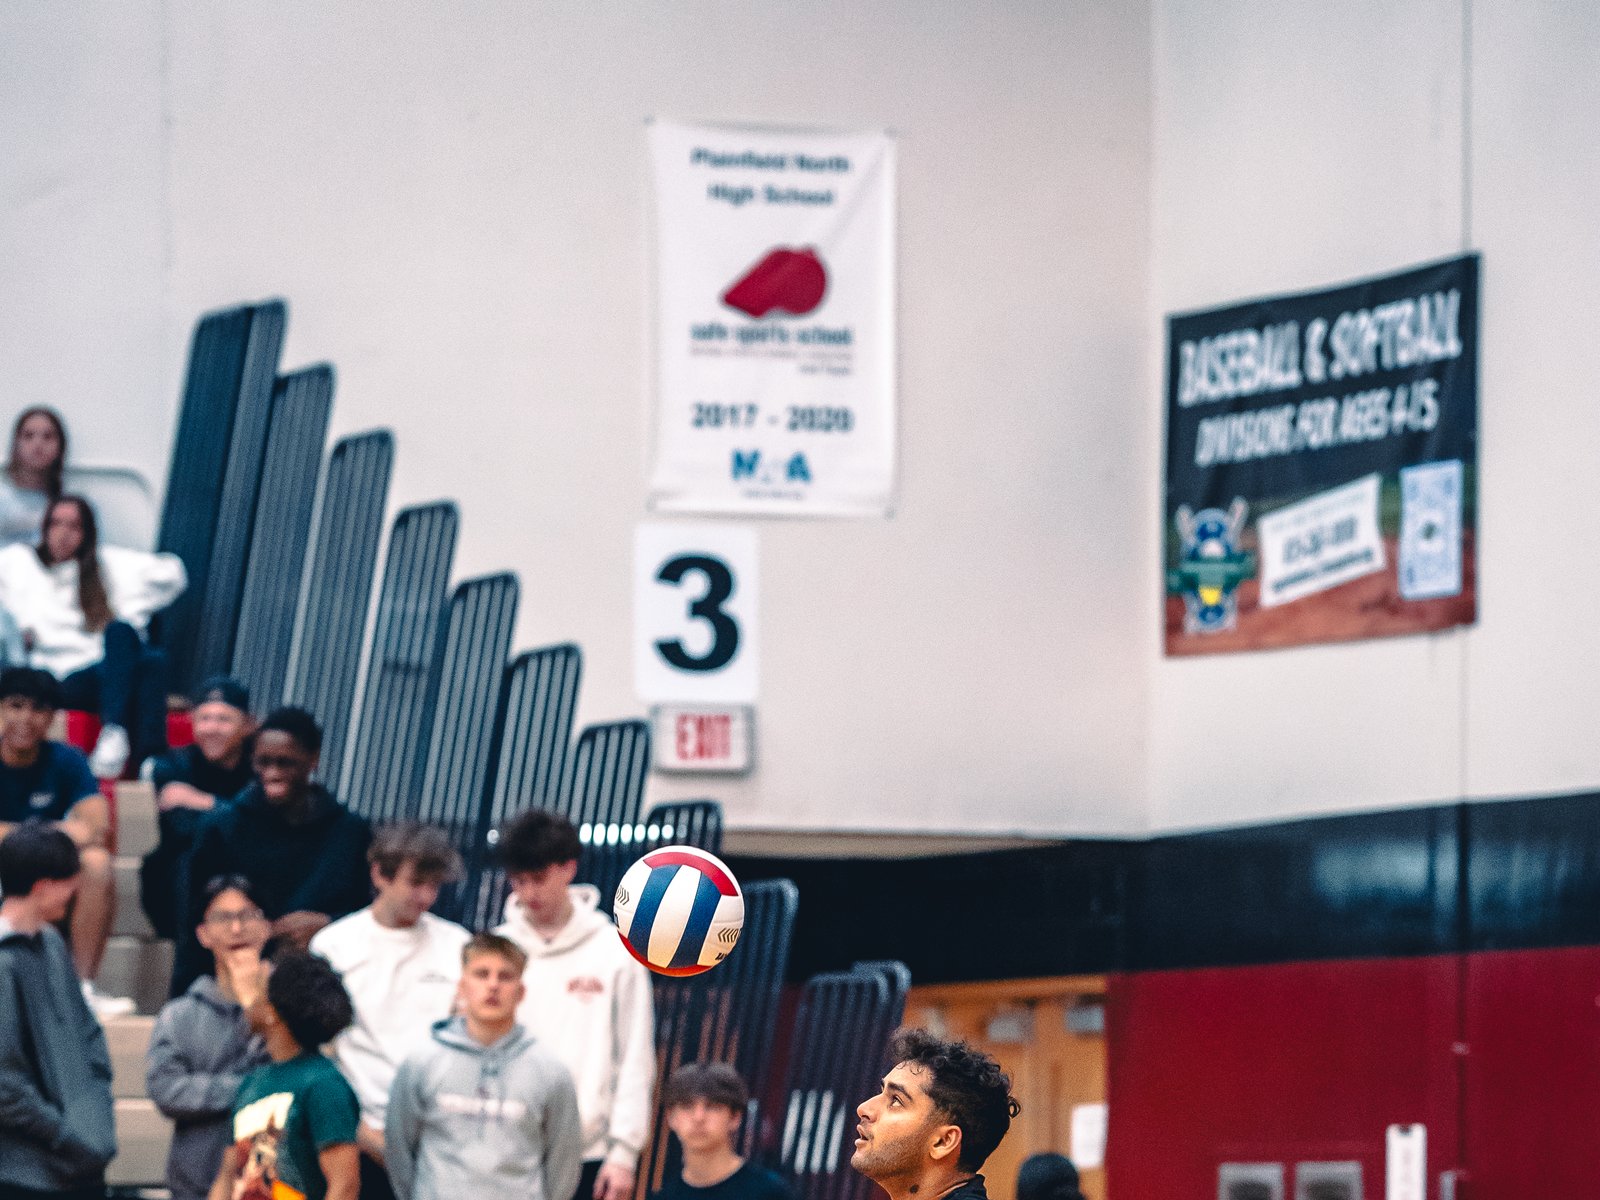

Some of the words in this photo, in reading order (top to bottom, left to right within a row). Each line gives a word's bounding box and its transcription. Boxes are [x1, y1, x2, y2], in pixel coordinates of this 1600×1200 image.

[706, 182, 754, 207] High
[764, 183, 835, 206] School
[1177, 318, 1302, 408] BASEBALL
[1329, 287, 1463, 381] SOFTBALL
[692, 402, 758, 429] 2017
[1338, 385, 1392, 446] AGES
[654, 551, 741, 674] 3
[675, 713, 731, 760] EXIT
